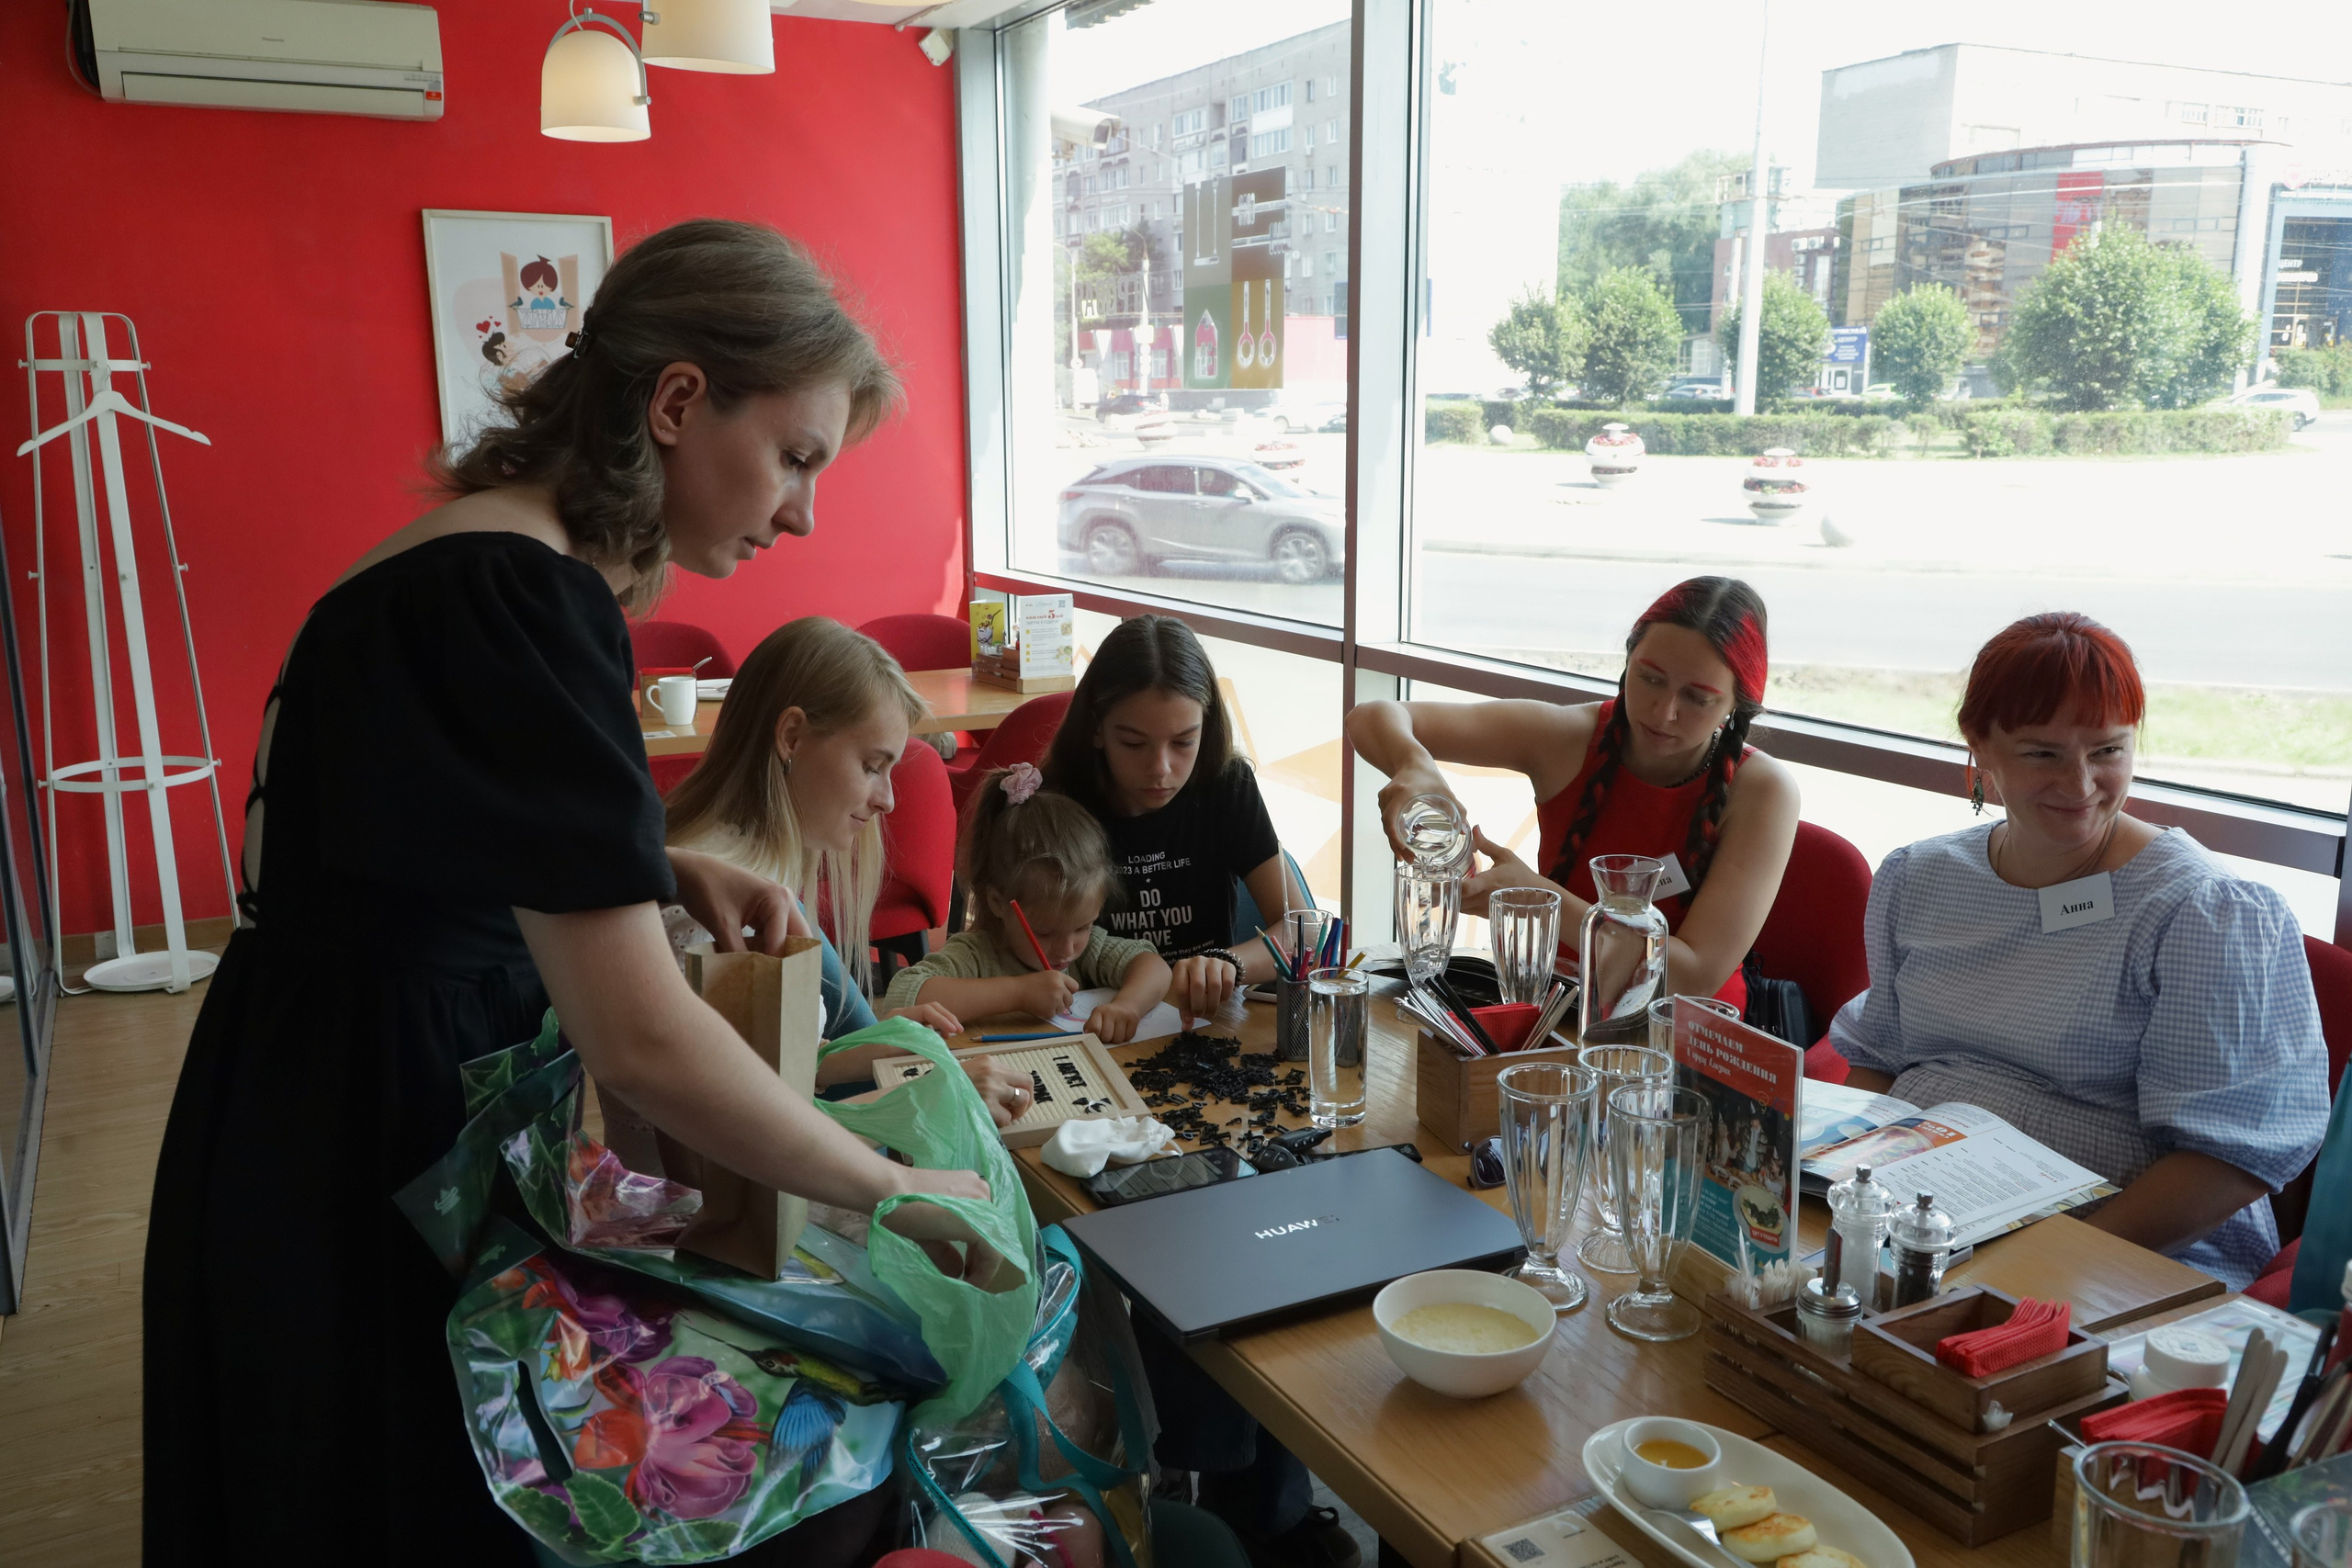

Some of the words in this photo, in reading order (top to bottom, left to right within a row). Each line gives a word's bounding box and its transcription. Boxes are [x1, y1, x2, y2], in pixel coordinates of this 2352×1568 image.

[1128, 852, 1166, 864] LOADING
[1134, 866, 1140, 874] A
[1142, 861, 1172, 874] BETTER
[1173, 857, 1192, 869] LIFE
[1139, 888, 1161, 908] DO
[2060, 900, 2094, 916] Анна
[1111, 910, 1156, 931] WHAT
[1159, 905, 1193, 927] YOU
[1178, 947, 1192, 955] they
[1202, 939, 1215, 948] easy
[1688, 1021, 1744, 1054] ОТМЕЧАЕМ
[1688, 1035, 1713, 1055] ДЕНЬ
[1716, 1048, 1778, 1085] РОЖДЕНИЯ
